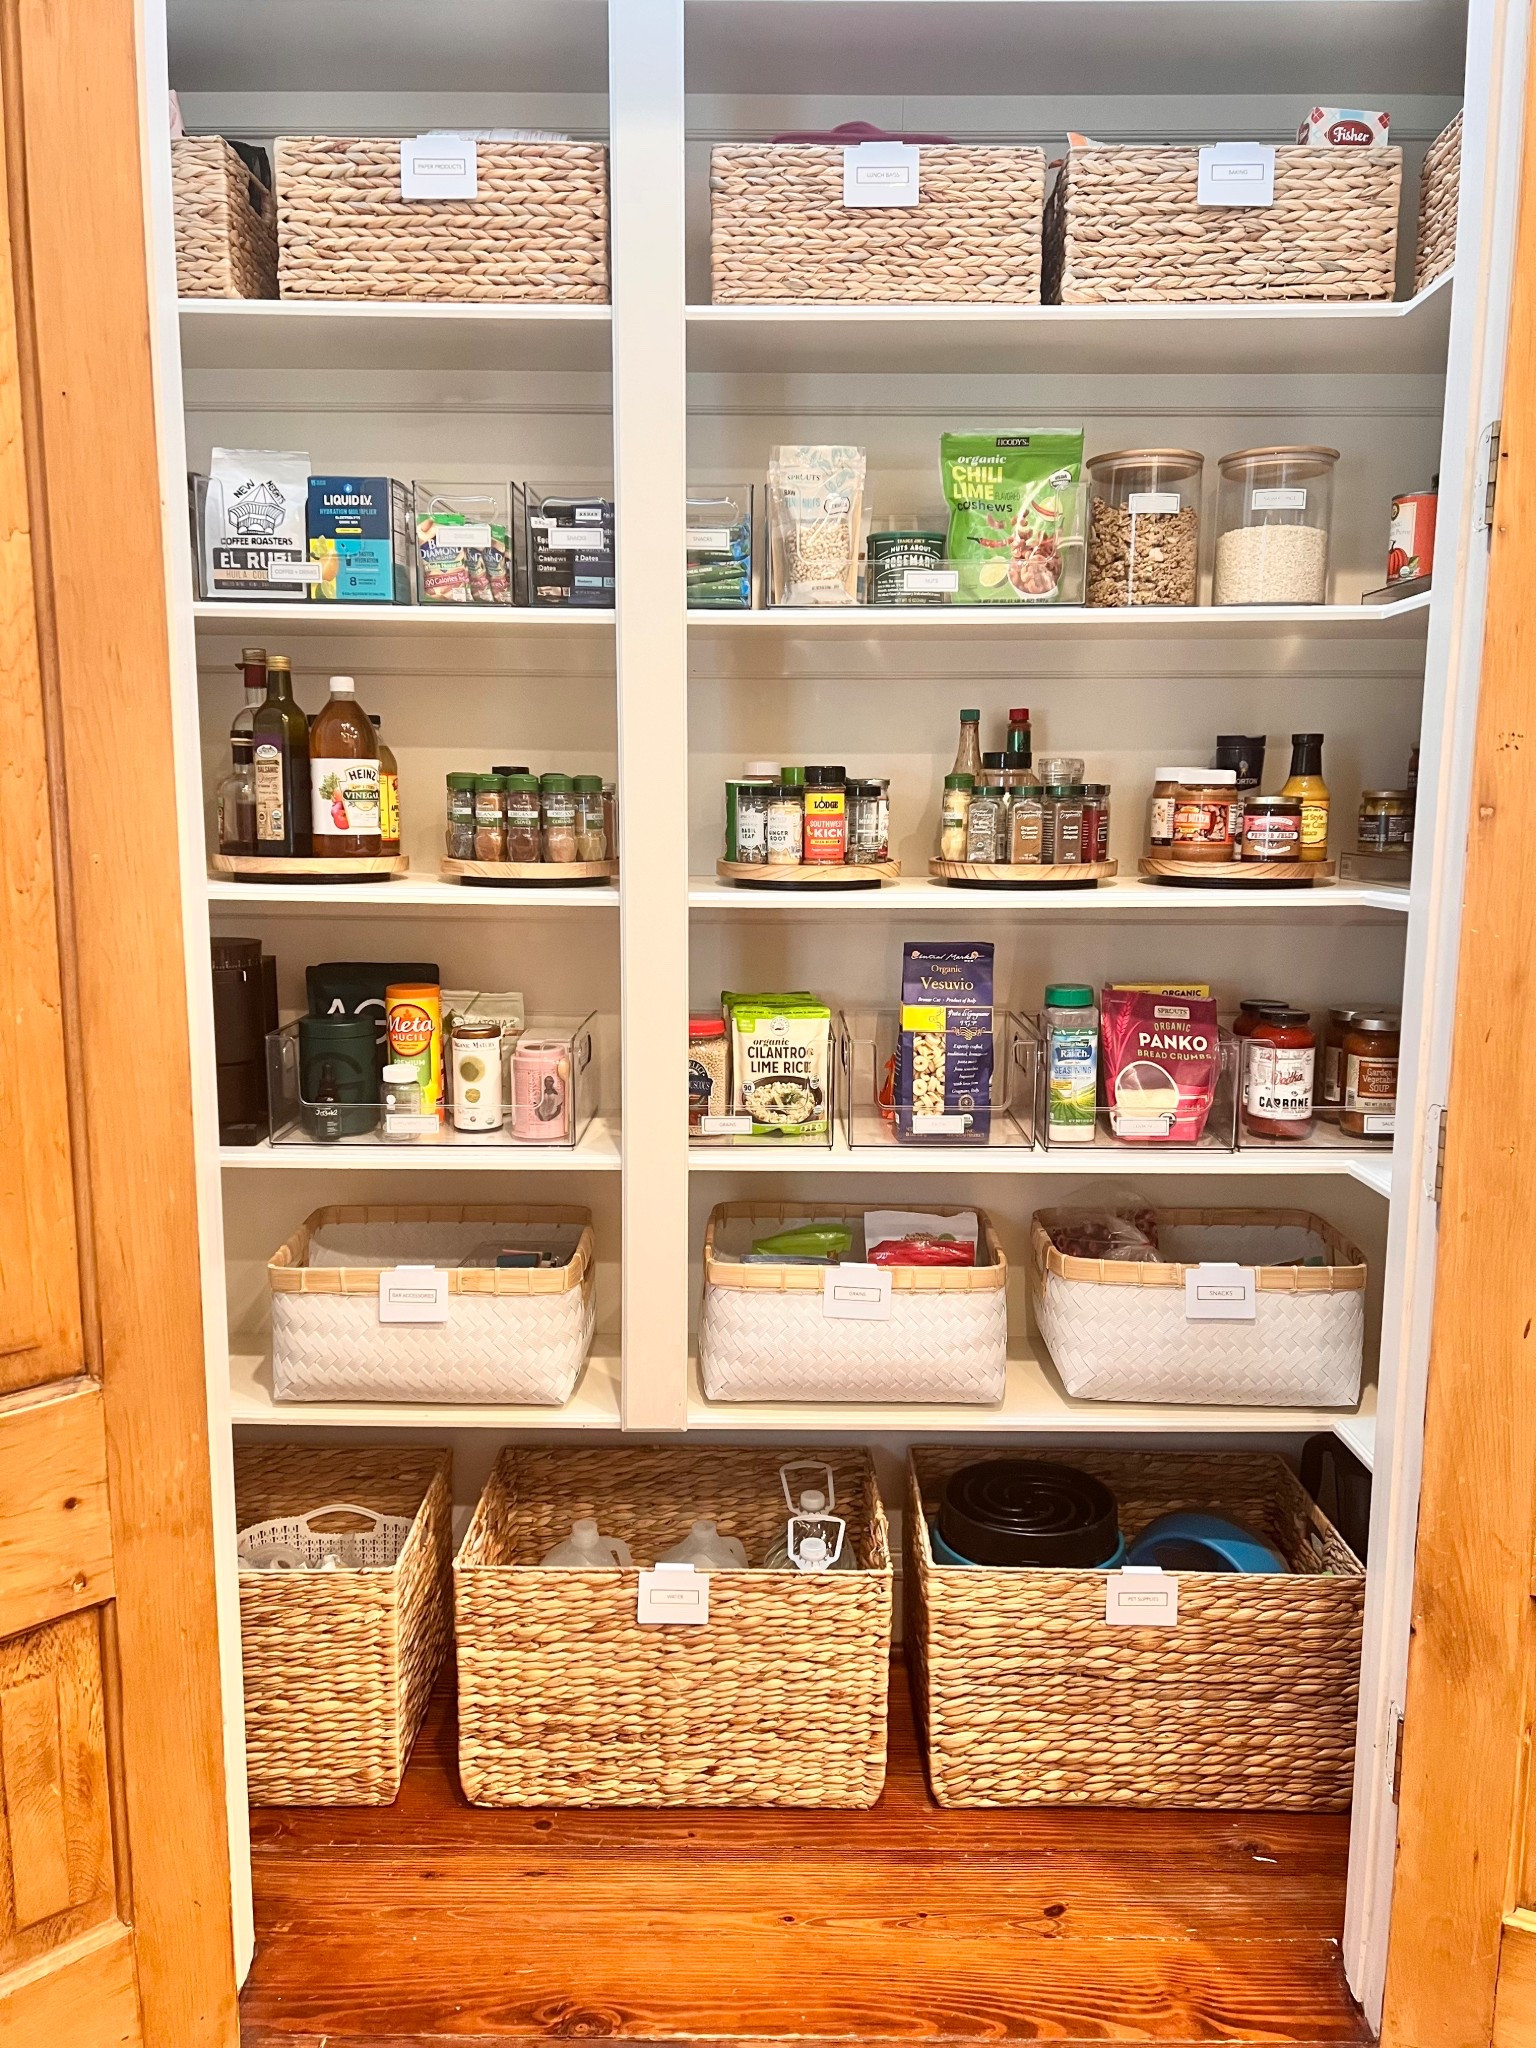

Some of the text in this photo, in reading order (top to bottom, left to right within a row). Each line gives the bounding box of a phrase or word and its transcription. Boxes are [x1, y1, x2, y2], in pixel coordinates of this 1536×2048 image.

[1333, 126, 1369, 142] Fisher
[997, 438, 1029, 446] HOODY'S
[957, 455, 1007, 466] organic
[952, 466, 1003, 483] CHILI
[233, 479, 255, 499] NEW
[953, 482, 994, 500] LIME
[323, 494, 360, 506] LIQUID
[957, 501, 1013, 512] cashews
[220, 537, 293, 546] COFFEE ROASTERS
[420, 547, 462, 559] DIAMOND
[890, 544, 932, 553] NUTS ABOUT
[220, 552, 241, 568] EL
[580, 554, 599, 562] Dates
[884, 554, 935, 570] ROSEMARY
[349, 577, 357, 586] 8
[348, 769, 377, 781] HEINZ
[814, 799, 839, 809] LODGE
[813, 828, 844, 838] KICK
[931, 964, 962, 975] Organic
[920, 976, 974, 991] Vesuvio
[389, 1014, 435, 1033] Meta
[1153, 1022, 1191, 1032] ORGANIC
[752, 1037, 790, 1047] organic
[1138, 1032, 1208, 1052] PANKO
[747, 1046, 807, 1059] CILANTRO
[1137, 1049, 1212, 1061] BREAD CRUMBS
[750, 1061, 779, 1074] LIME
[1366, 1068, 1393, 1076] Garden
[1362, 1075, 1397, 1085] Vegetable
[1368, 1084, 1390, 1092] SOUP
[1259, 1096, 1309, 1109] CARBONE
